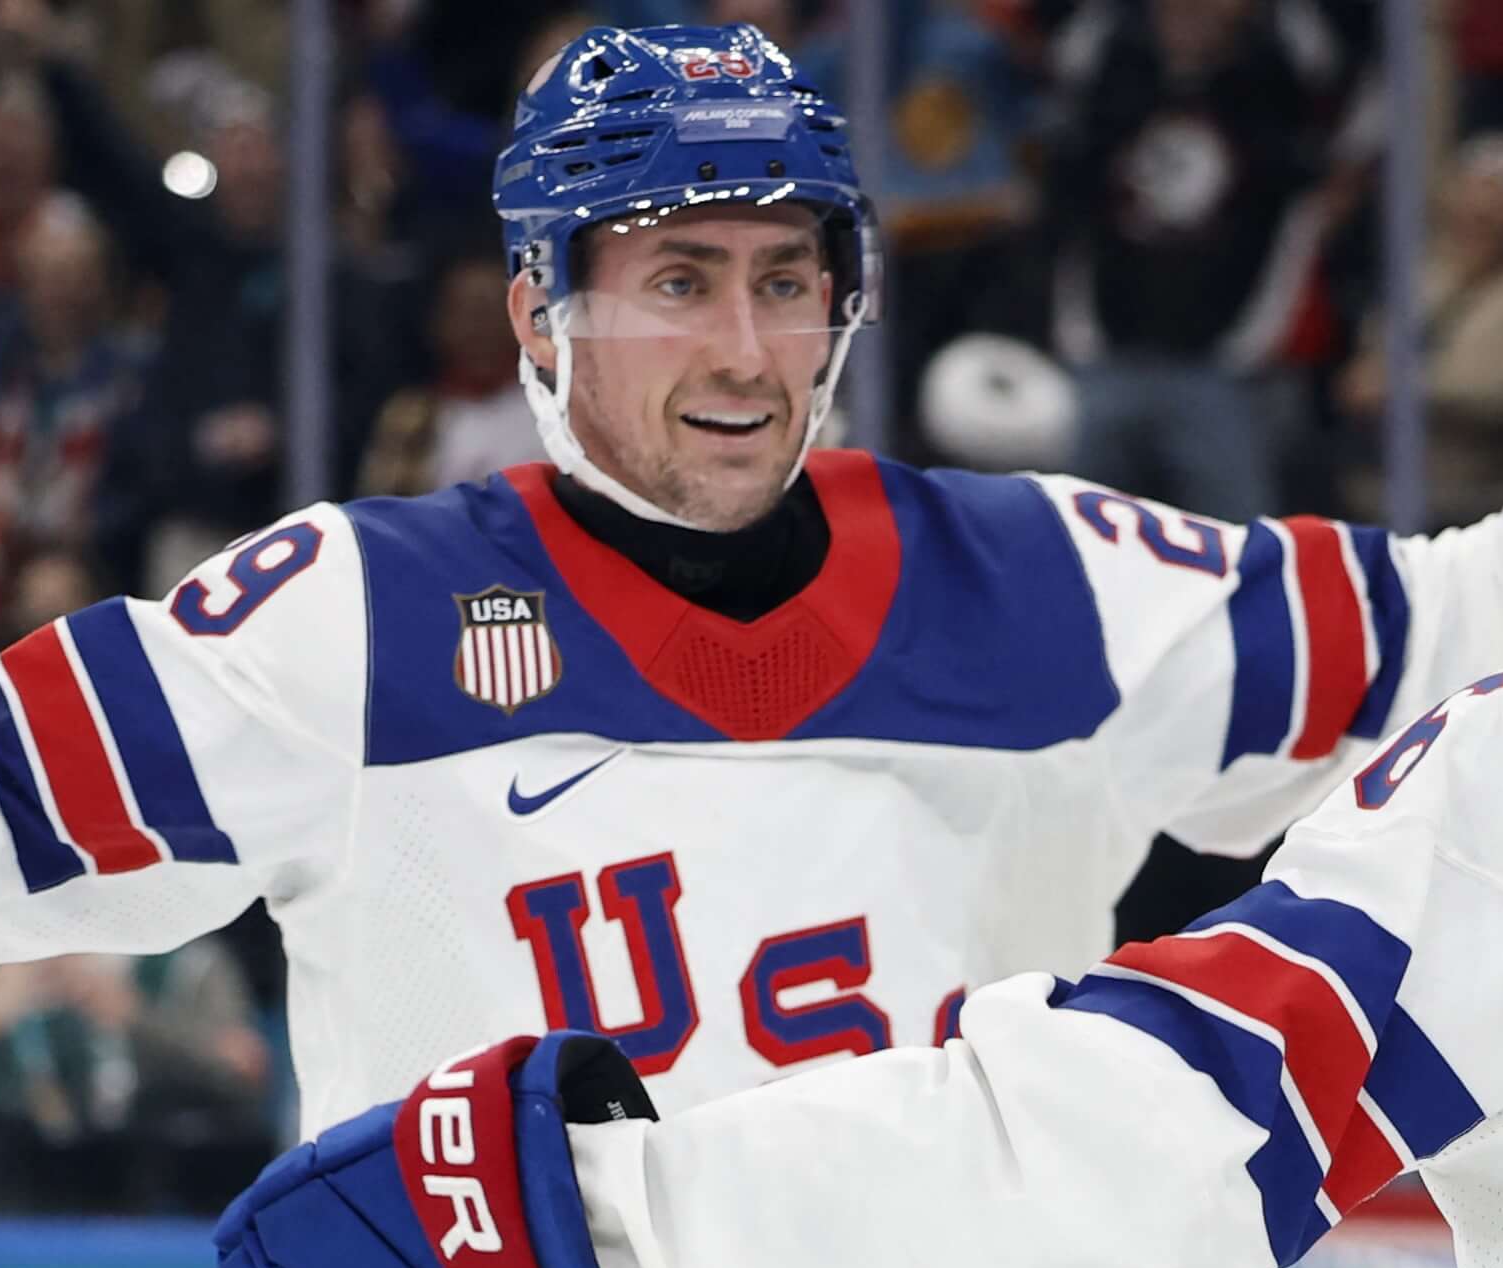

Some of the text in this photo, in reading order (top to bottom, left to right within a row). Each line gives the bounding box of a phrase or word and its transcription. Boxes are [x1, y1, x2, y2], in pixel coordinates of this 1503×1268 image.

[169, 521, 325, 637] 9
[470, 597, 533, 622] USA
[504, 850, 967, 1079] US
